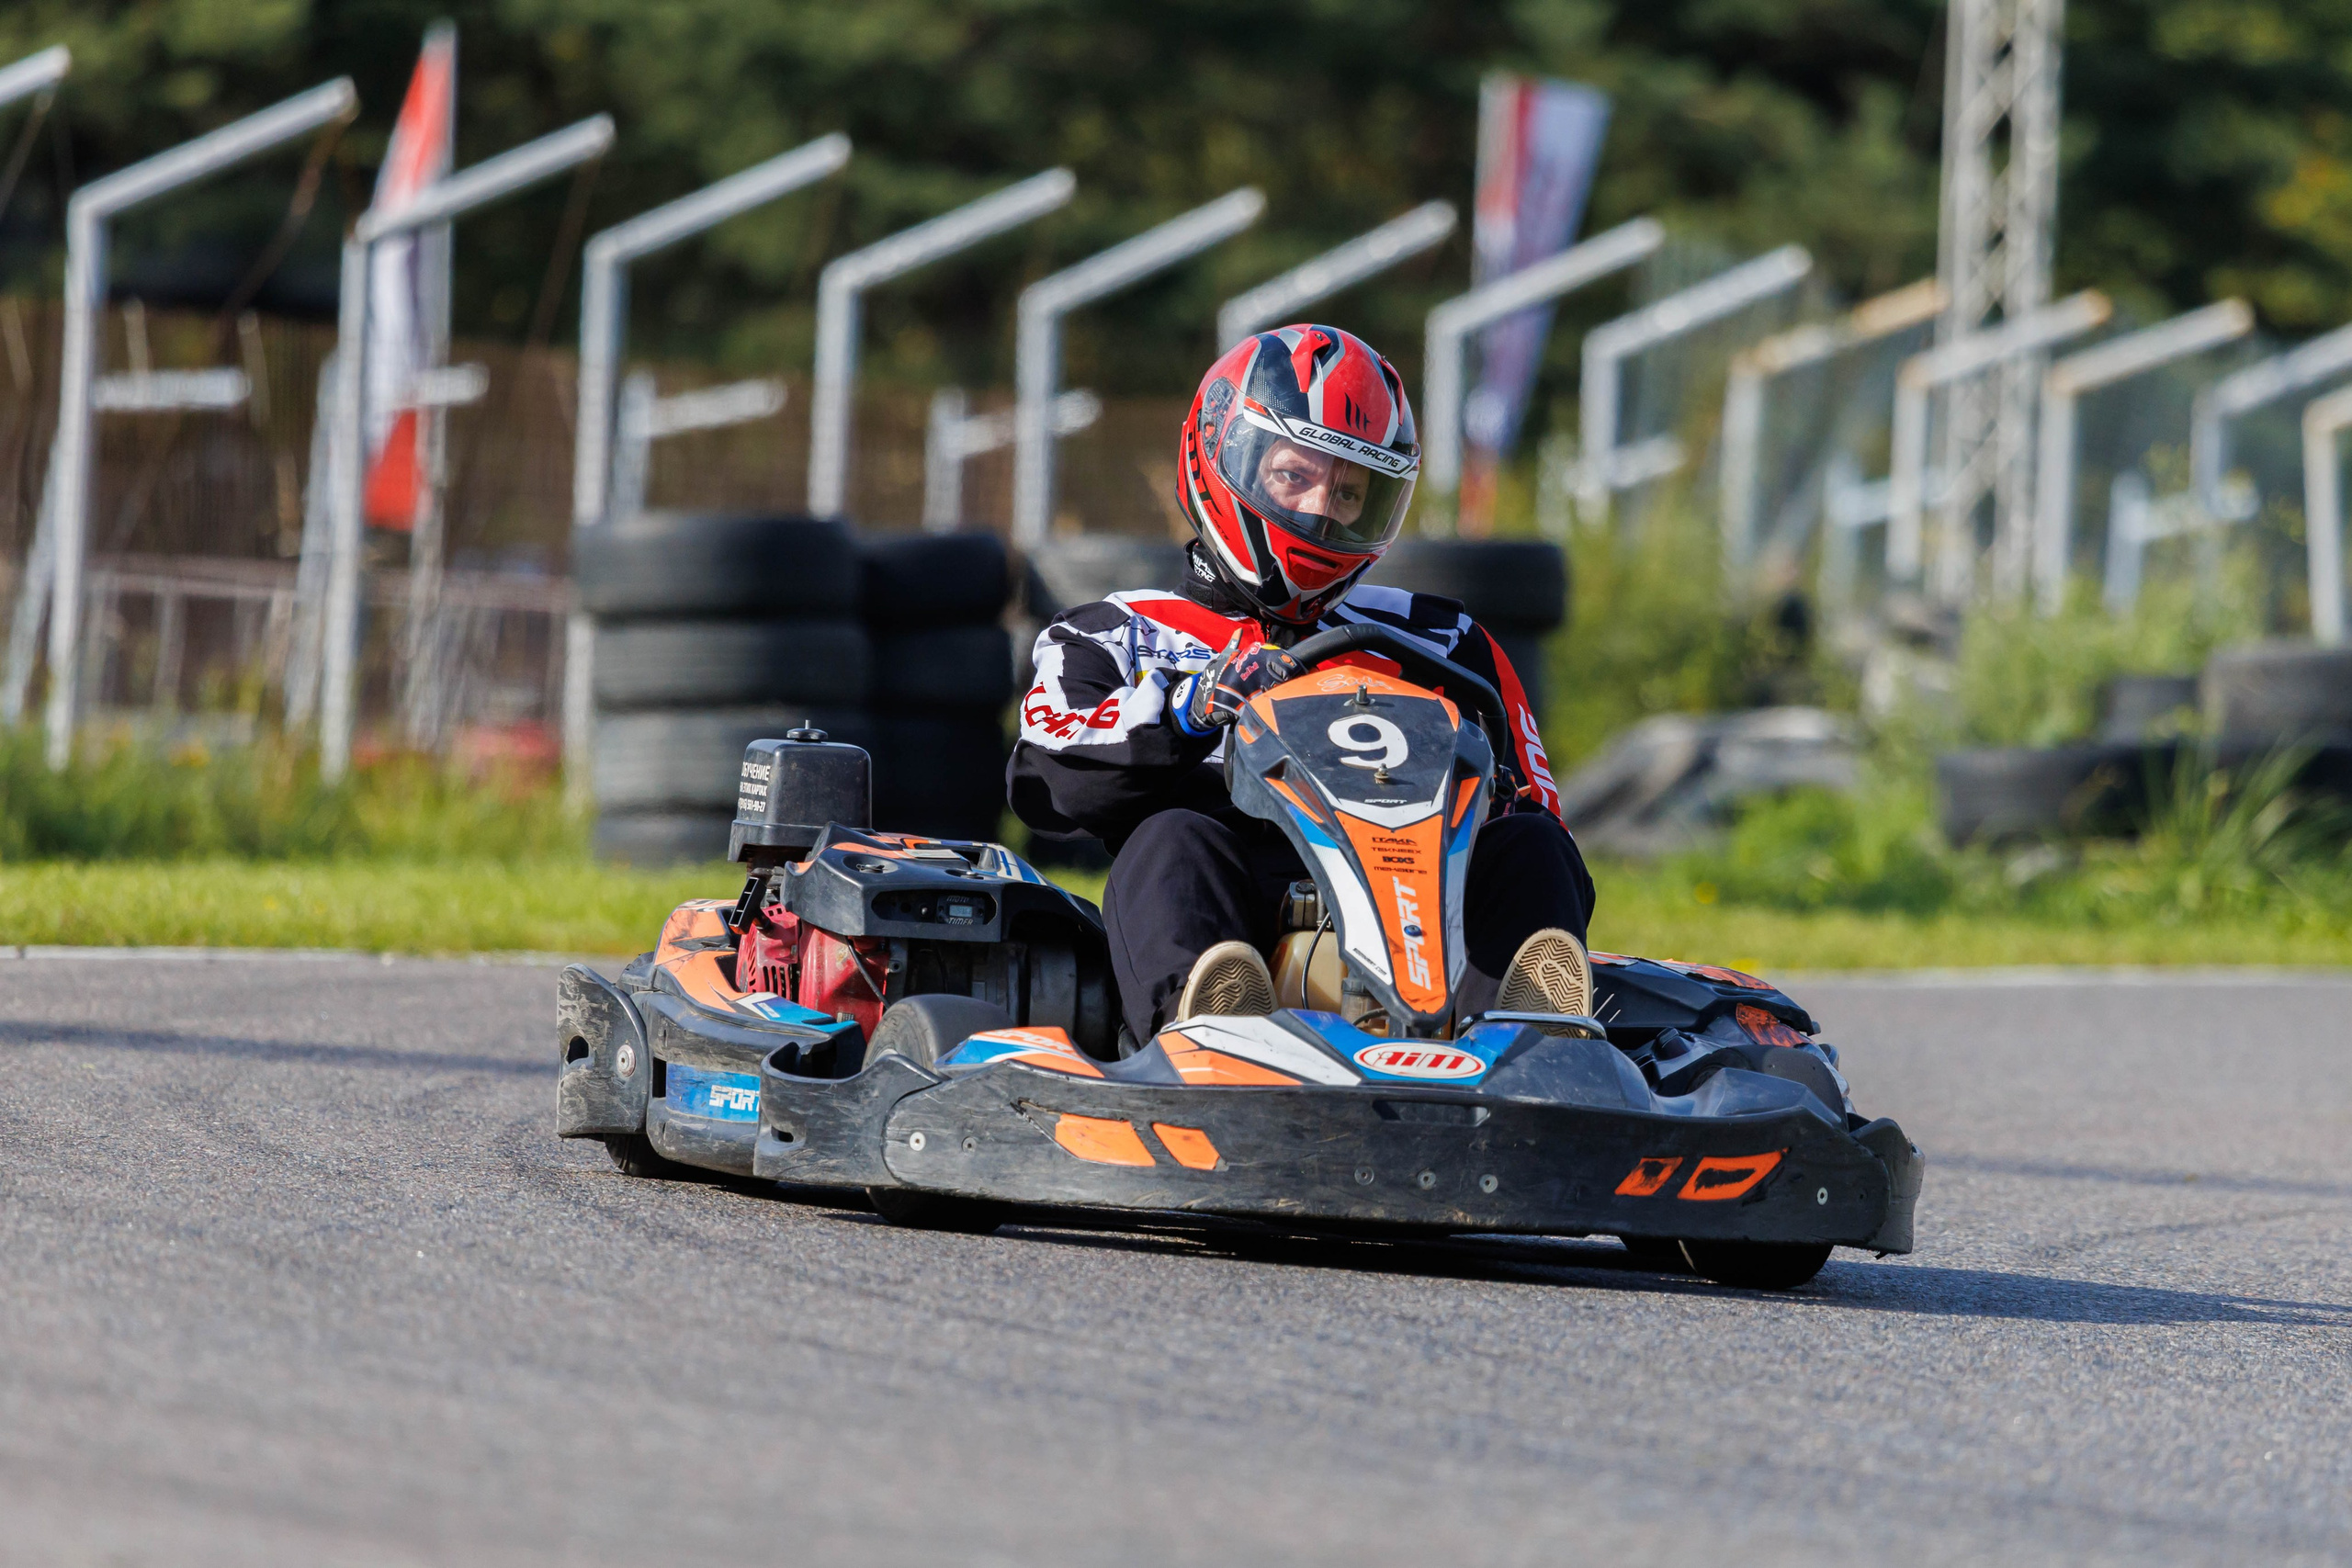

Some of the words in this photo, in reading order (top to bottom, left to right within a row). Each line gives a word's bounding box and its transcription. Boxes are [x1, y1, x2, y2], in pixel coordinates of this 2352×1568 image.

[1299, 427, 1356, 450] GLOBAL
[1358, 445, 1401, 468] RACING
[1204, 503, 1229, 540] HELMETS
[1328, 713, 1408, 770] 9
[948, 917, 974, 925] TIMER
[1392, 875, 1431, 991] SPORT
